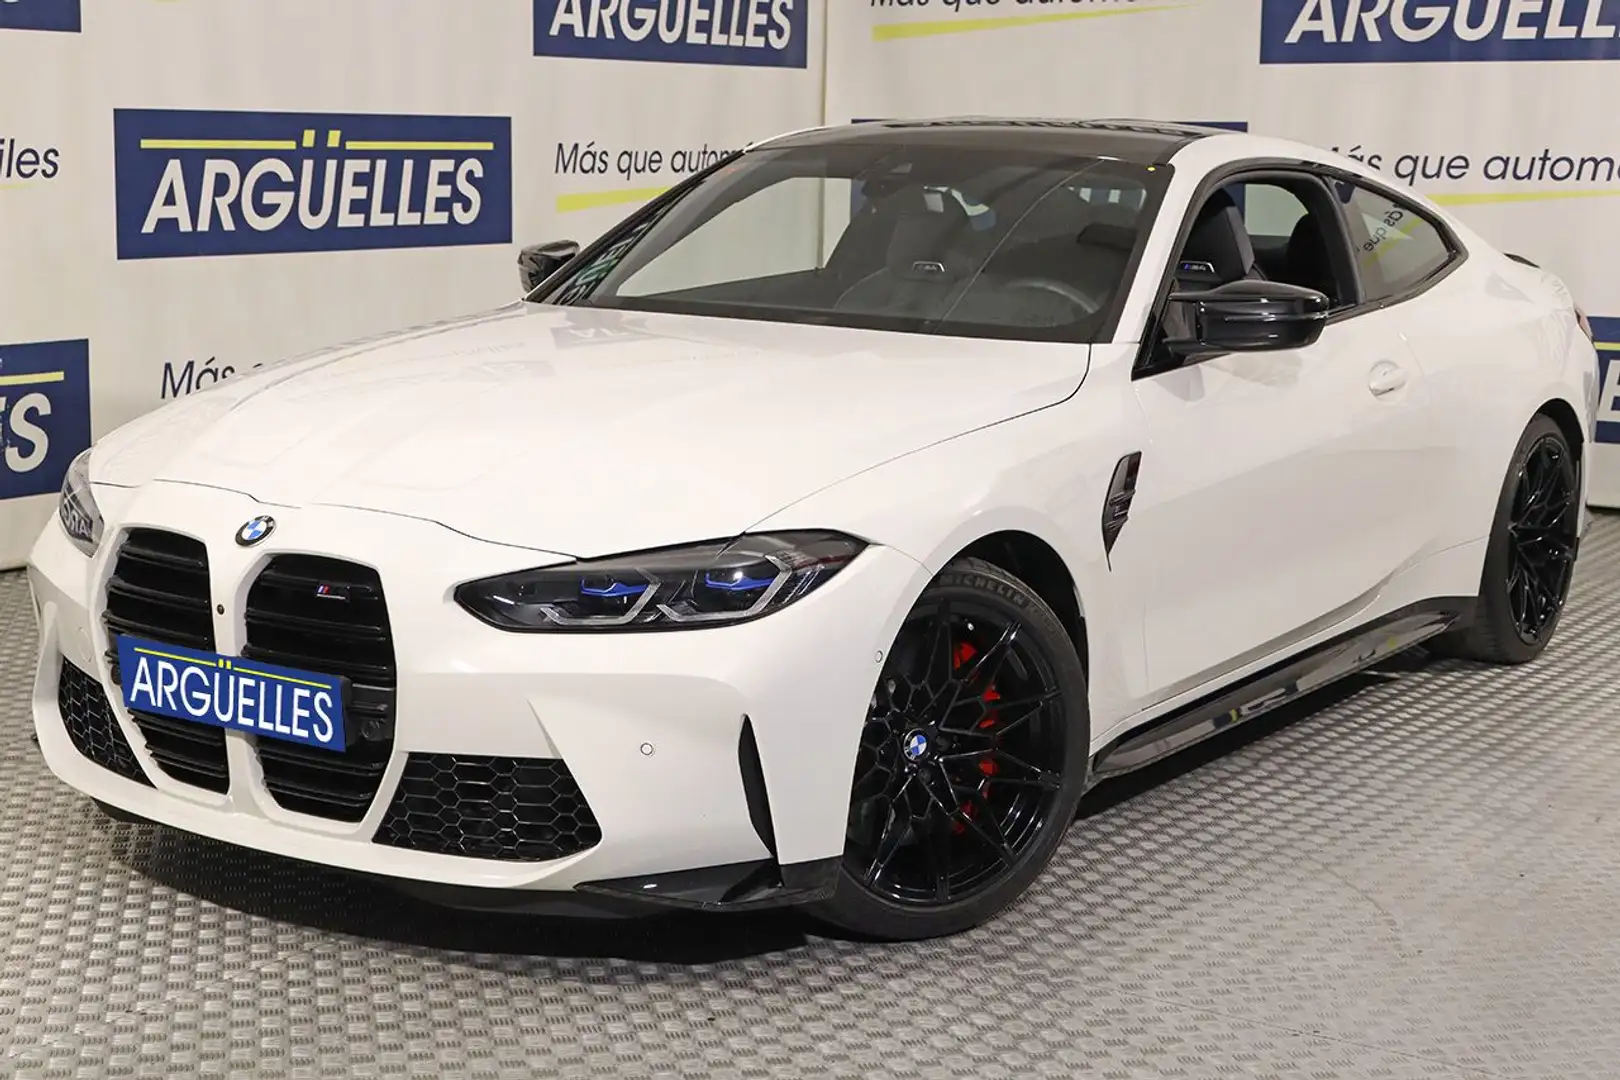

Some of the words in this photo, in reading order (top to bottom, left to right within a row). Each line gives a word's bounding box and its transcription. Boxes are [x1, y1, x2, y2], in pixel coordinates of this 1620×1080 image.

[555, 141, 608, 174] Más
[617, 150, 662, 180] que
[1394, 154, 1469, 186] que
[1483, 149, 1620, 181] autom
[141, 130, 484, 233] ARGÜELLES
[940, 573, 1025, 606] MICHELIN
[130, 656, 333, 742] ARGÜELLES
